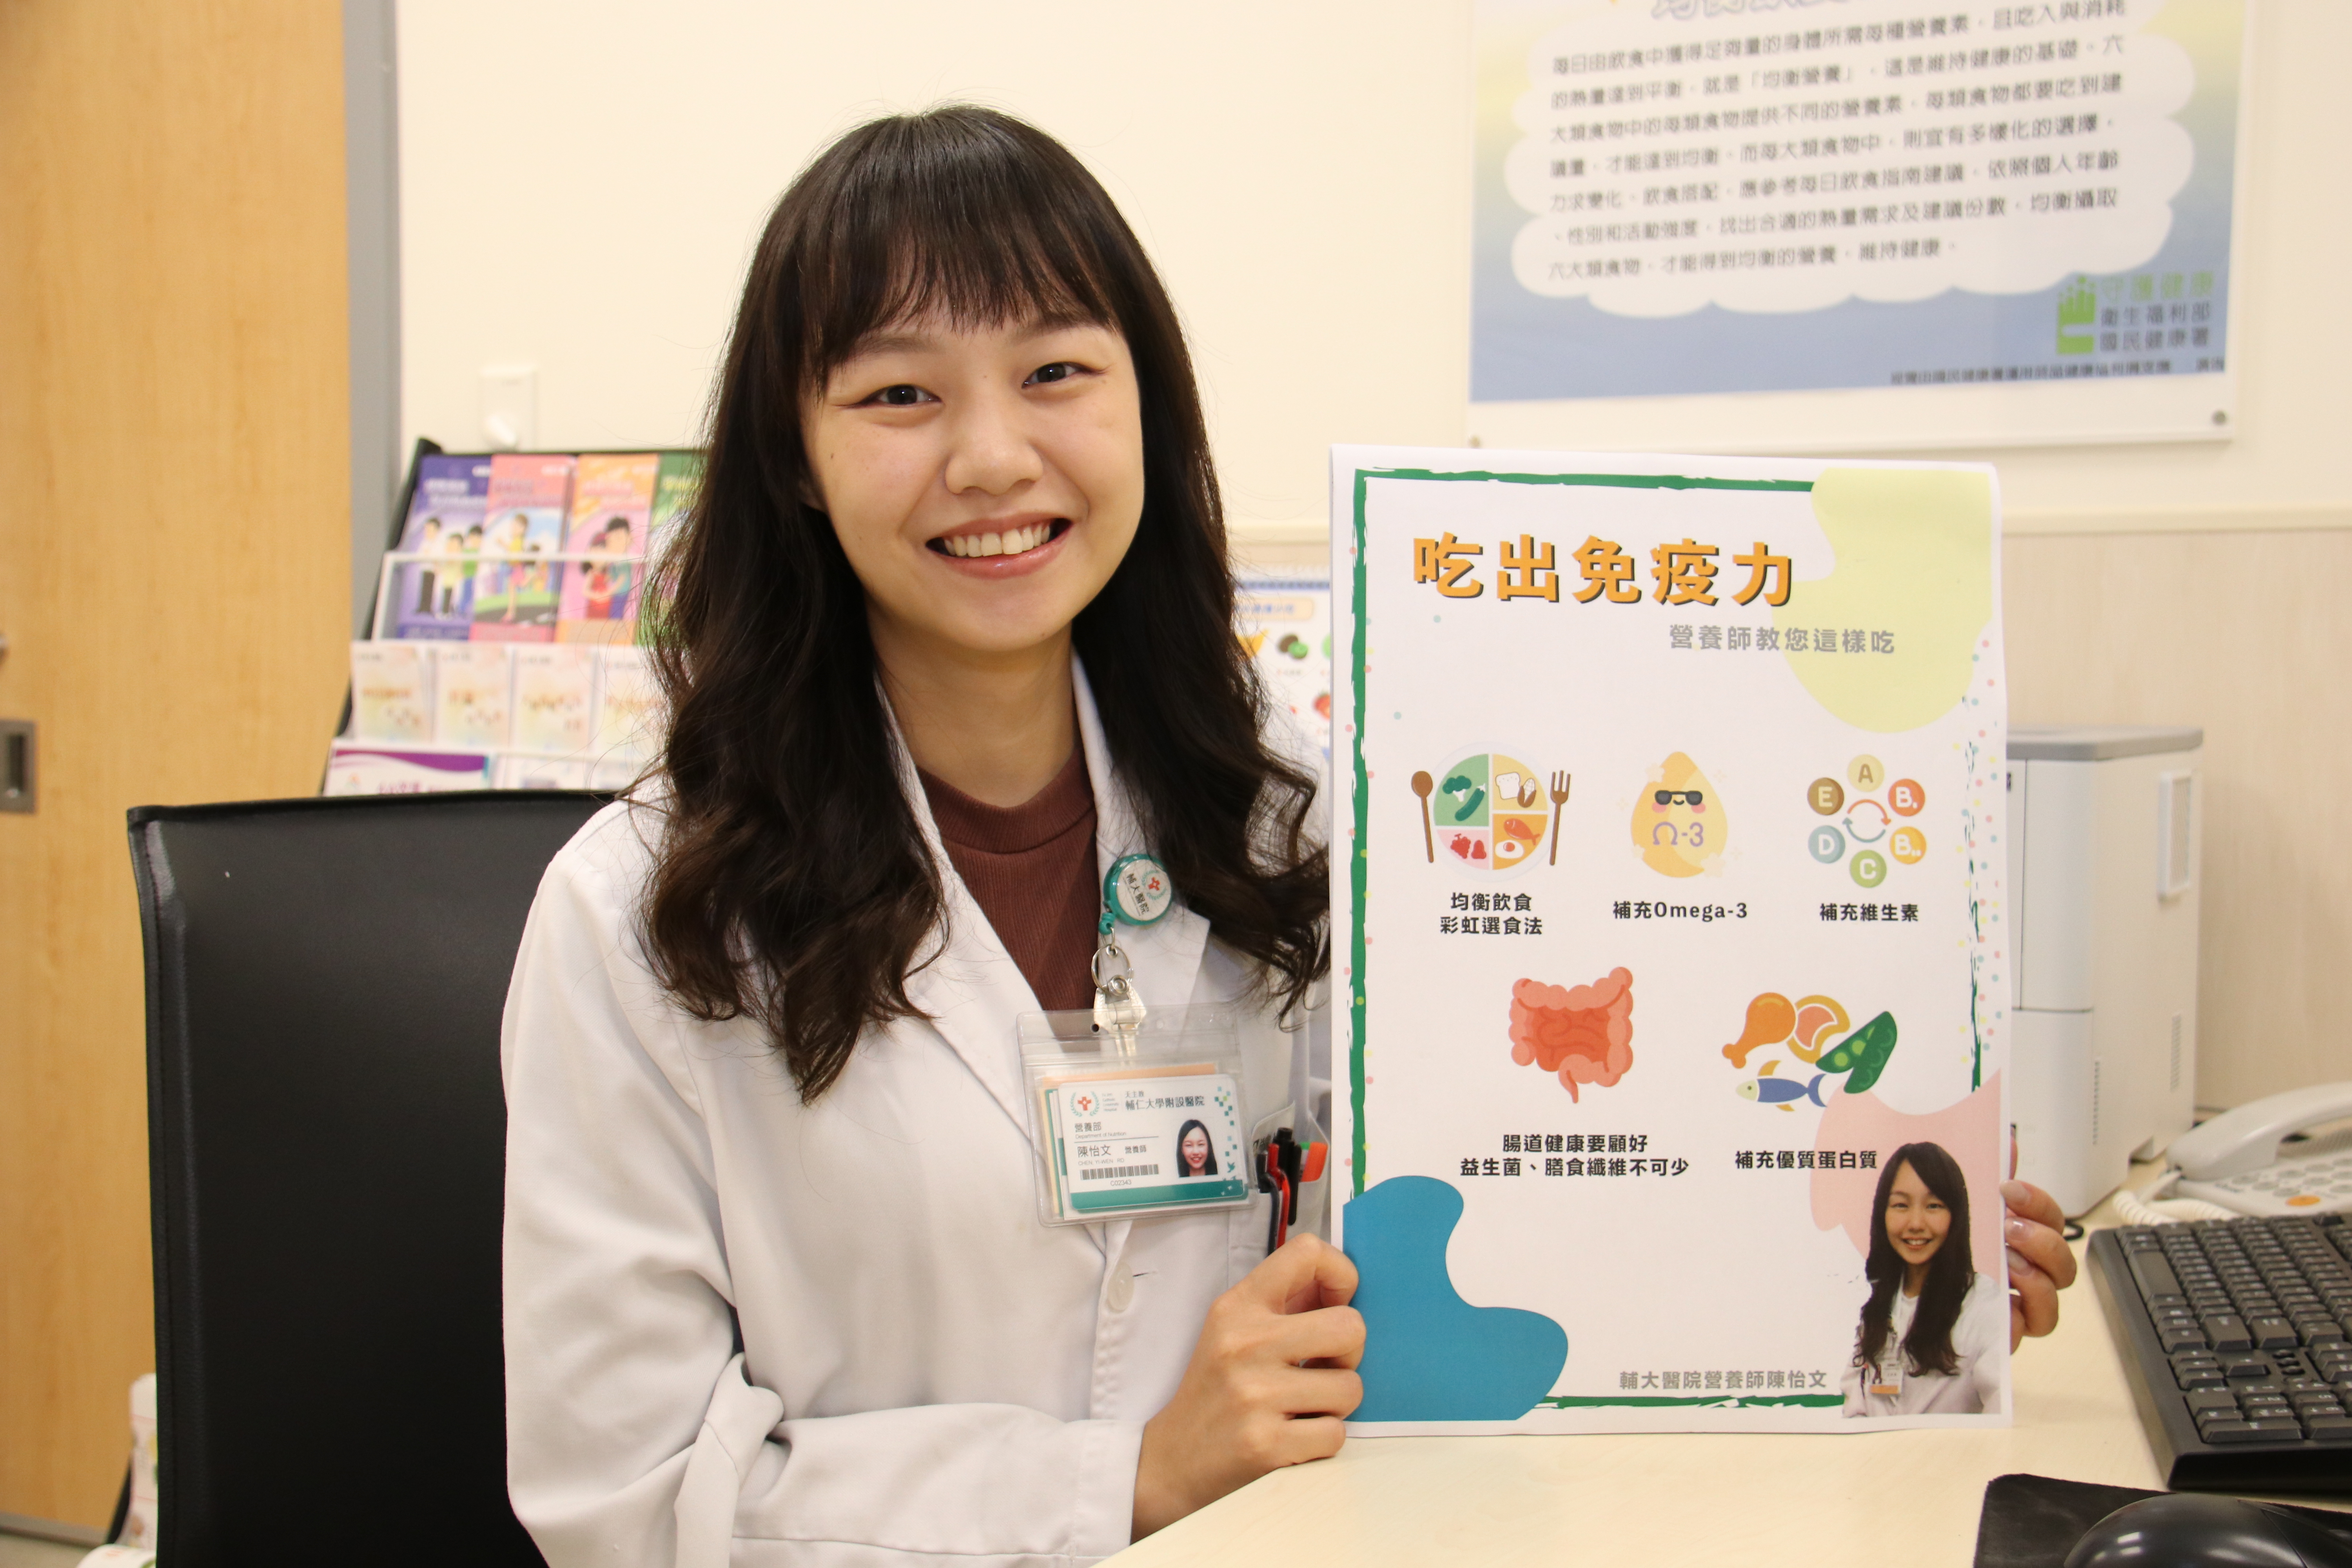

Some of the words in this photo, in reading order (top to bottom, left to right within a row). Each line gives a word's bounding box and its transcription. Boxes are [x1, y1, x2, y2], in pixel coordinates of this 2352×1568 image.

[1413, 531, 1792, 607] 吃出免疫力
[1670, 624, 1895, 654] 營養師教您這樣吃
[1858, 763, 1873, 783] A
[1818, 786, 1833, 807] E
[1818, 834, 1835, 855] D
[1860, 858, 1877, 879] C
[1451, 892, 1532, 911] 均衡飲食
[1613, 901, 1748, 922] 補充Omega-3
[1820, 904, 1918, 922] 補充維生素
[1440, 916, 1543, 935] 彩虹選食法
[1125, 1096, 1205, 1111] 輔仁大學附設醫院
[1074, 1122, 1102, 1132] 營養部
[1077, 1144, 1111, 1158] 陳怡文
[1125, 1145, 1147, 1154] 營養師
[1503, 1134, 1648, 1152] 腸道健康要顧好
[1460, 1158, 1689, 1176] 益生菌、膳食纖維不可少
[1735, 1151, 1877, 1169] 補充優質蛋白質
[1619, 1370, 1827, 1390] 輔大醫院營養師陳怡文
